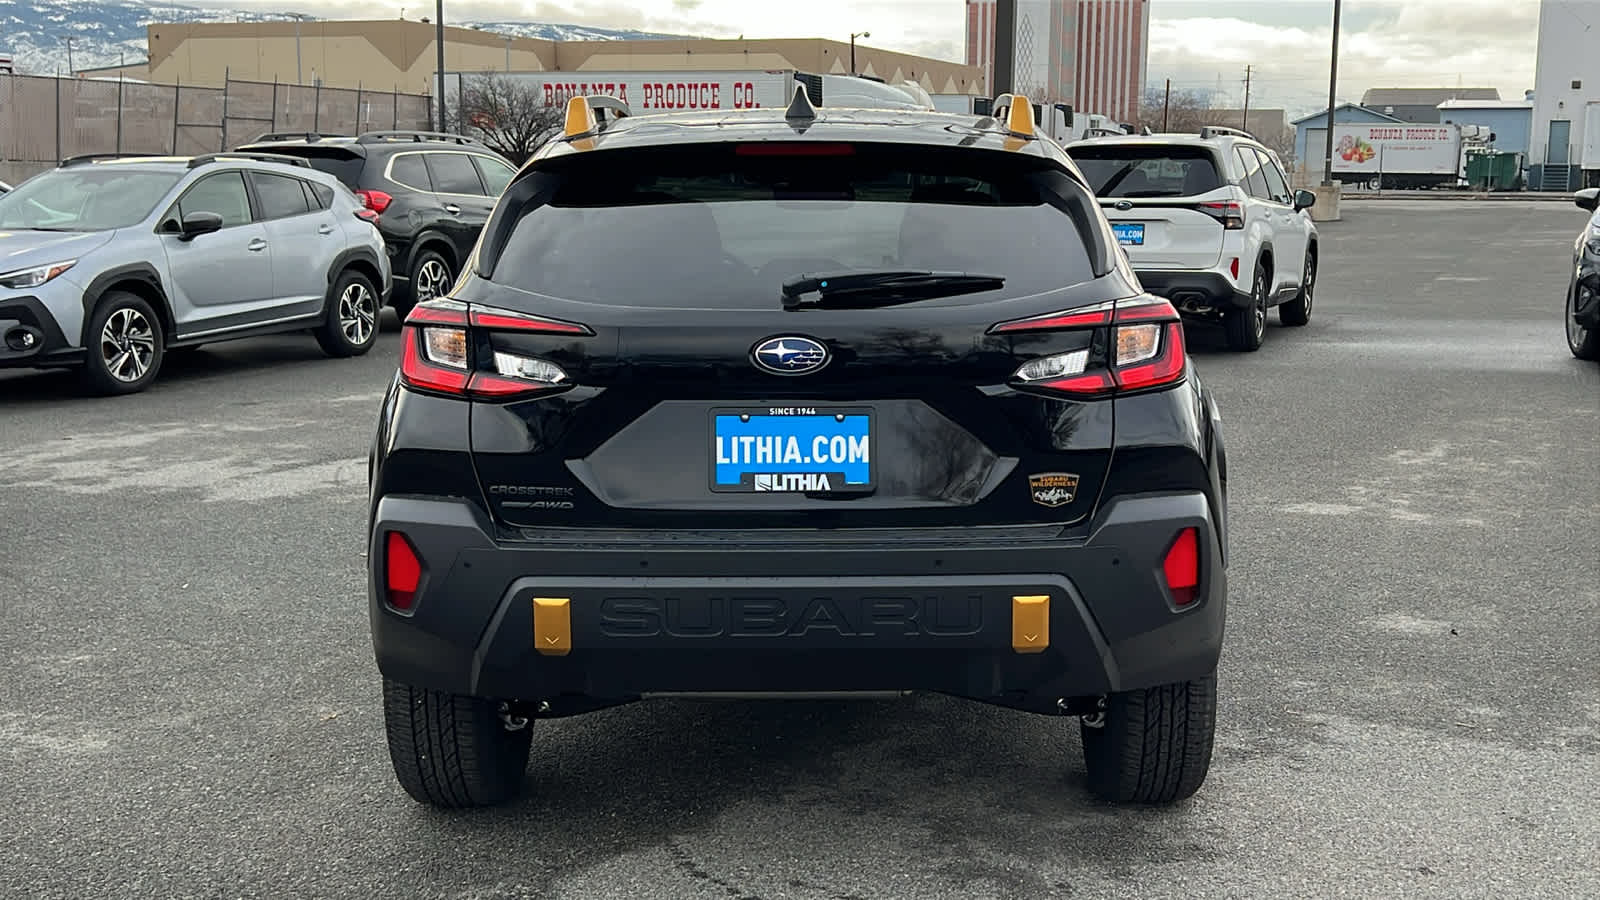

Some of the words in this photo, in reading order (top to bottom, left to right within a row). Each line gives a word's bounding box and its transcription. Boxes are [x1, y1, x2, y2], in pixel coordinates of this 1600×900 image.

[642, 83, 720, 109] PRODUCE
[733, 82, 761, 109] CO.
[769, 407, 795, 416] SINCE
[716, 435, 869, 464] LITHIA.COM
[772, 474, 831, 490] LITHIA
[489, 485, 574, 497] CROSSTREK
[530, 501, 574, 509] AWD
[599, 595, 984, 639] SUBARU
